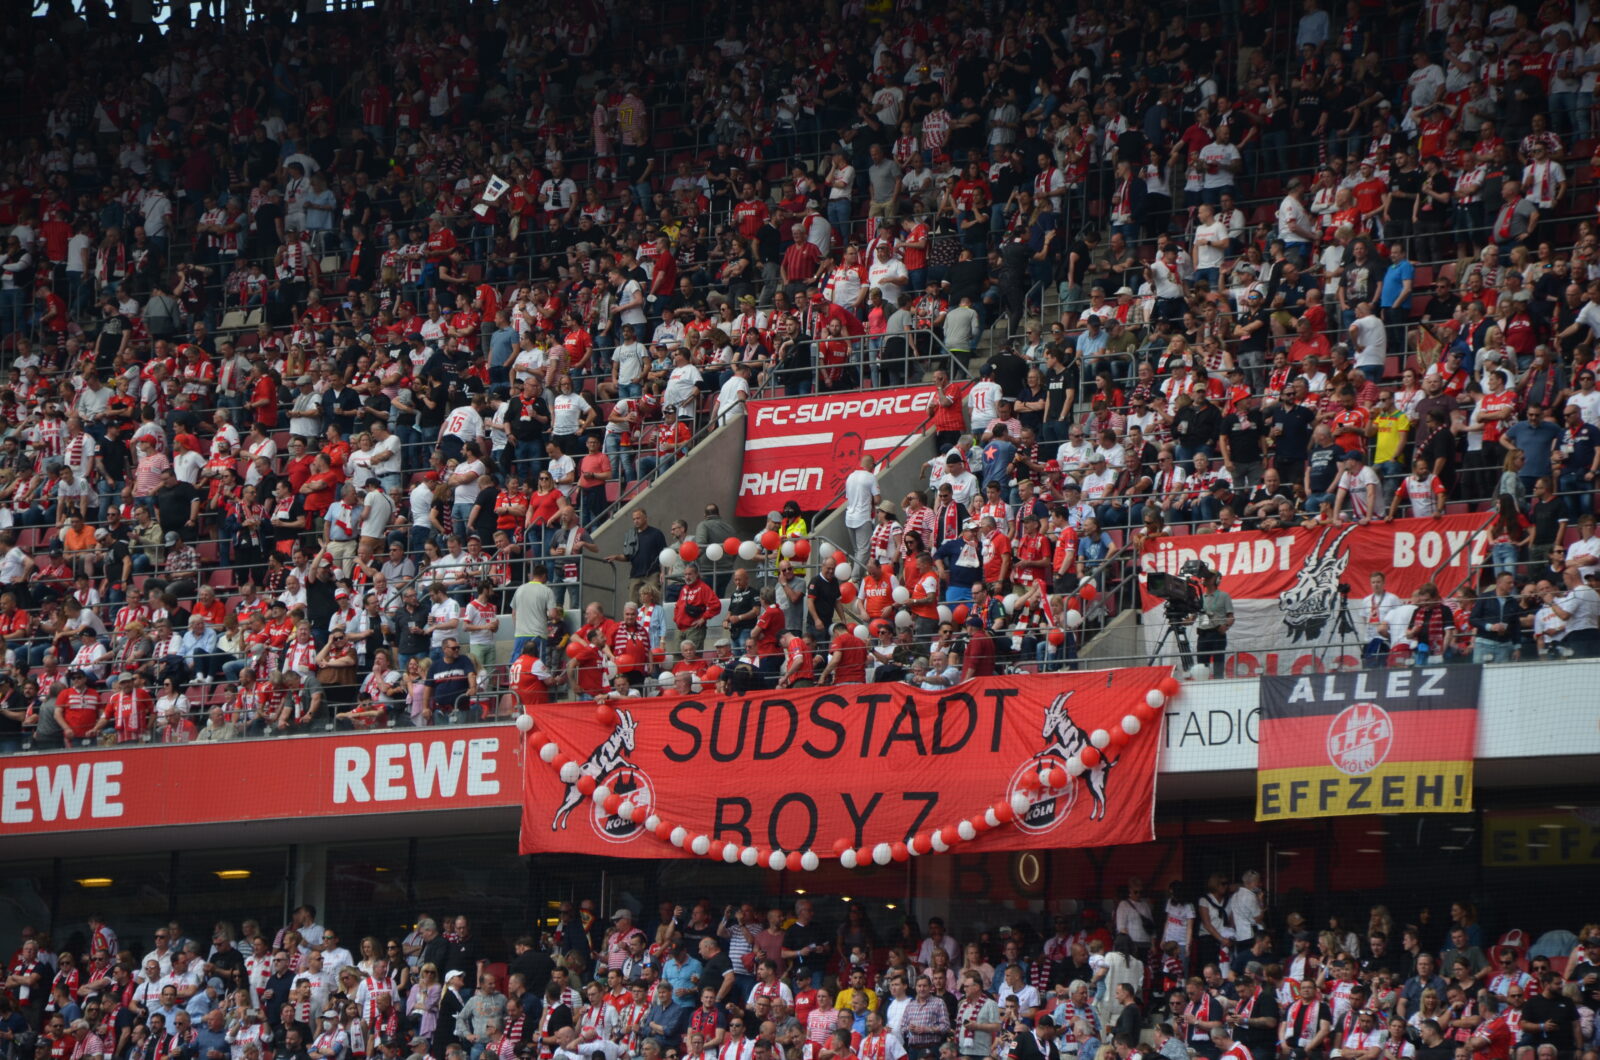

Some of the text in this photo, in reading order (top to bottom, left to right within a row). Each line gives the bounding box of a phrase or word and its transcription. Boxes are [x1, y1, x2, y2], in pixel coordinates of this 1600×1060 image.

[974, 392, 986, 409] 11
[449, 416, 465, 434] 15
[739, 467, 824, 497] RHEIN
[1392, 531, 1488, 569] BOYZ
[866, 588, 887, 597] REWE
[1288, 668, 1447, 703] ALLEZ
[333, 738, 500, 804] REWE
[1262, 774, 1465, 815] EFFZEH!
[714, 791, 939, 853] BOYZ
